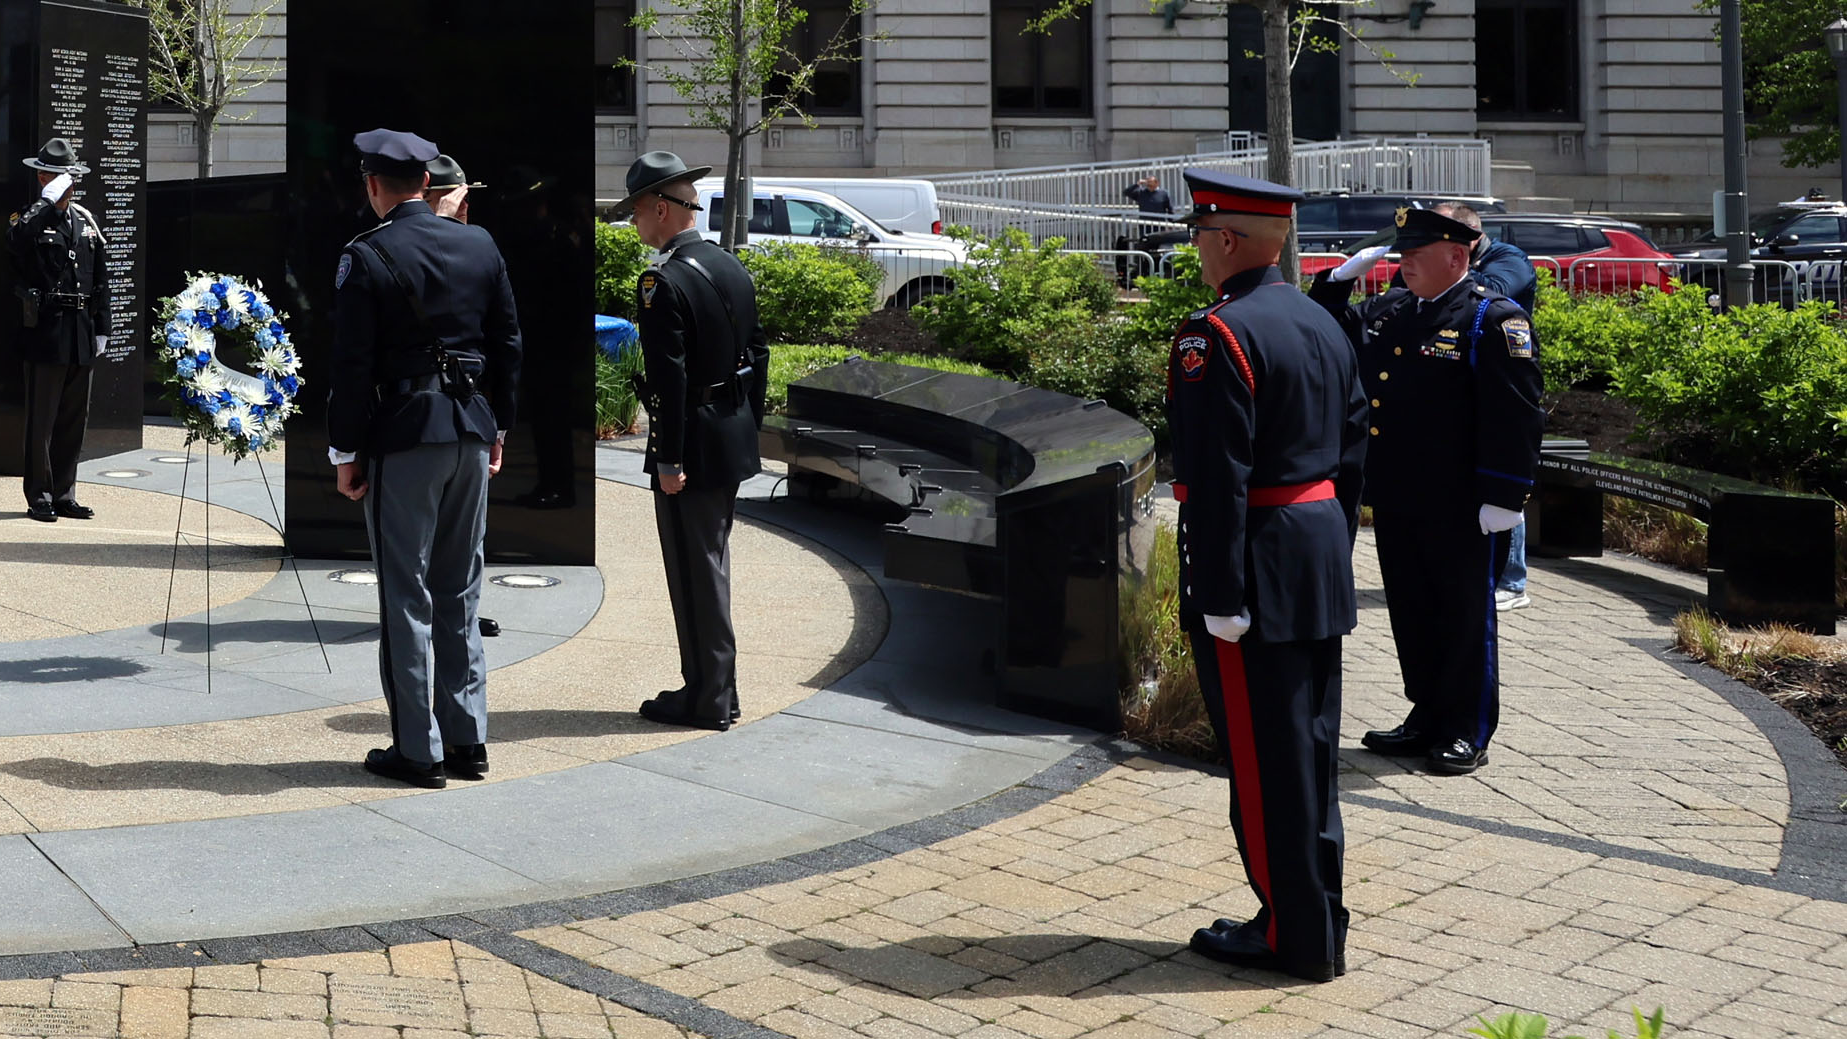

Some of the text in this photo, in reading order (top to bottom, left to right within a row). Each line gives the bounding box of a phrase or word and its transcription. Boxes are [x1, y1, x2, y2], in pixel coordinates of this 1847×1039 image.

[1179, 336, 1206, 344] HAMILTON
[1179, 341, 1207, 351] POLICE
[1582, 466, 1598, 476] POLICE
[1600, 470, 1621, 480] OFFICERS
[1632, 478, 1643, 486] MADE
[1654, 483, 1671, 494] ULTIMATE
[1672, 487, 1688, 498] SACRIFICE
[1596, 480, 1622, 492] CLEVELAND
[1623, 486, 1637, 495] POLICE
[1638, 489, 1664, 502] PATROLMEN'S
